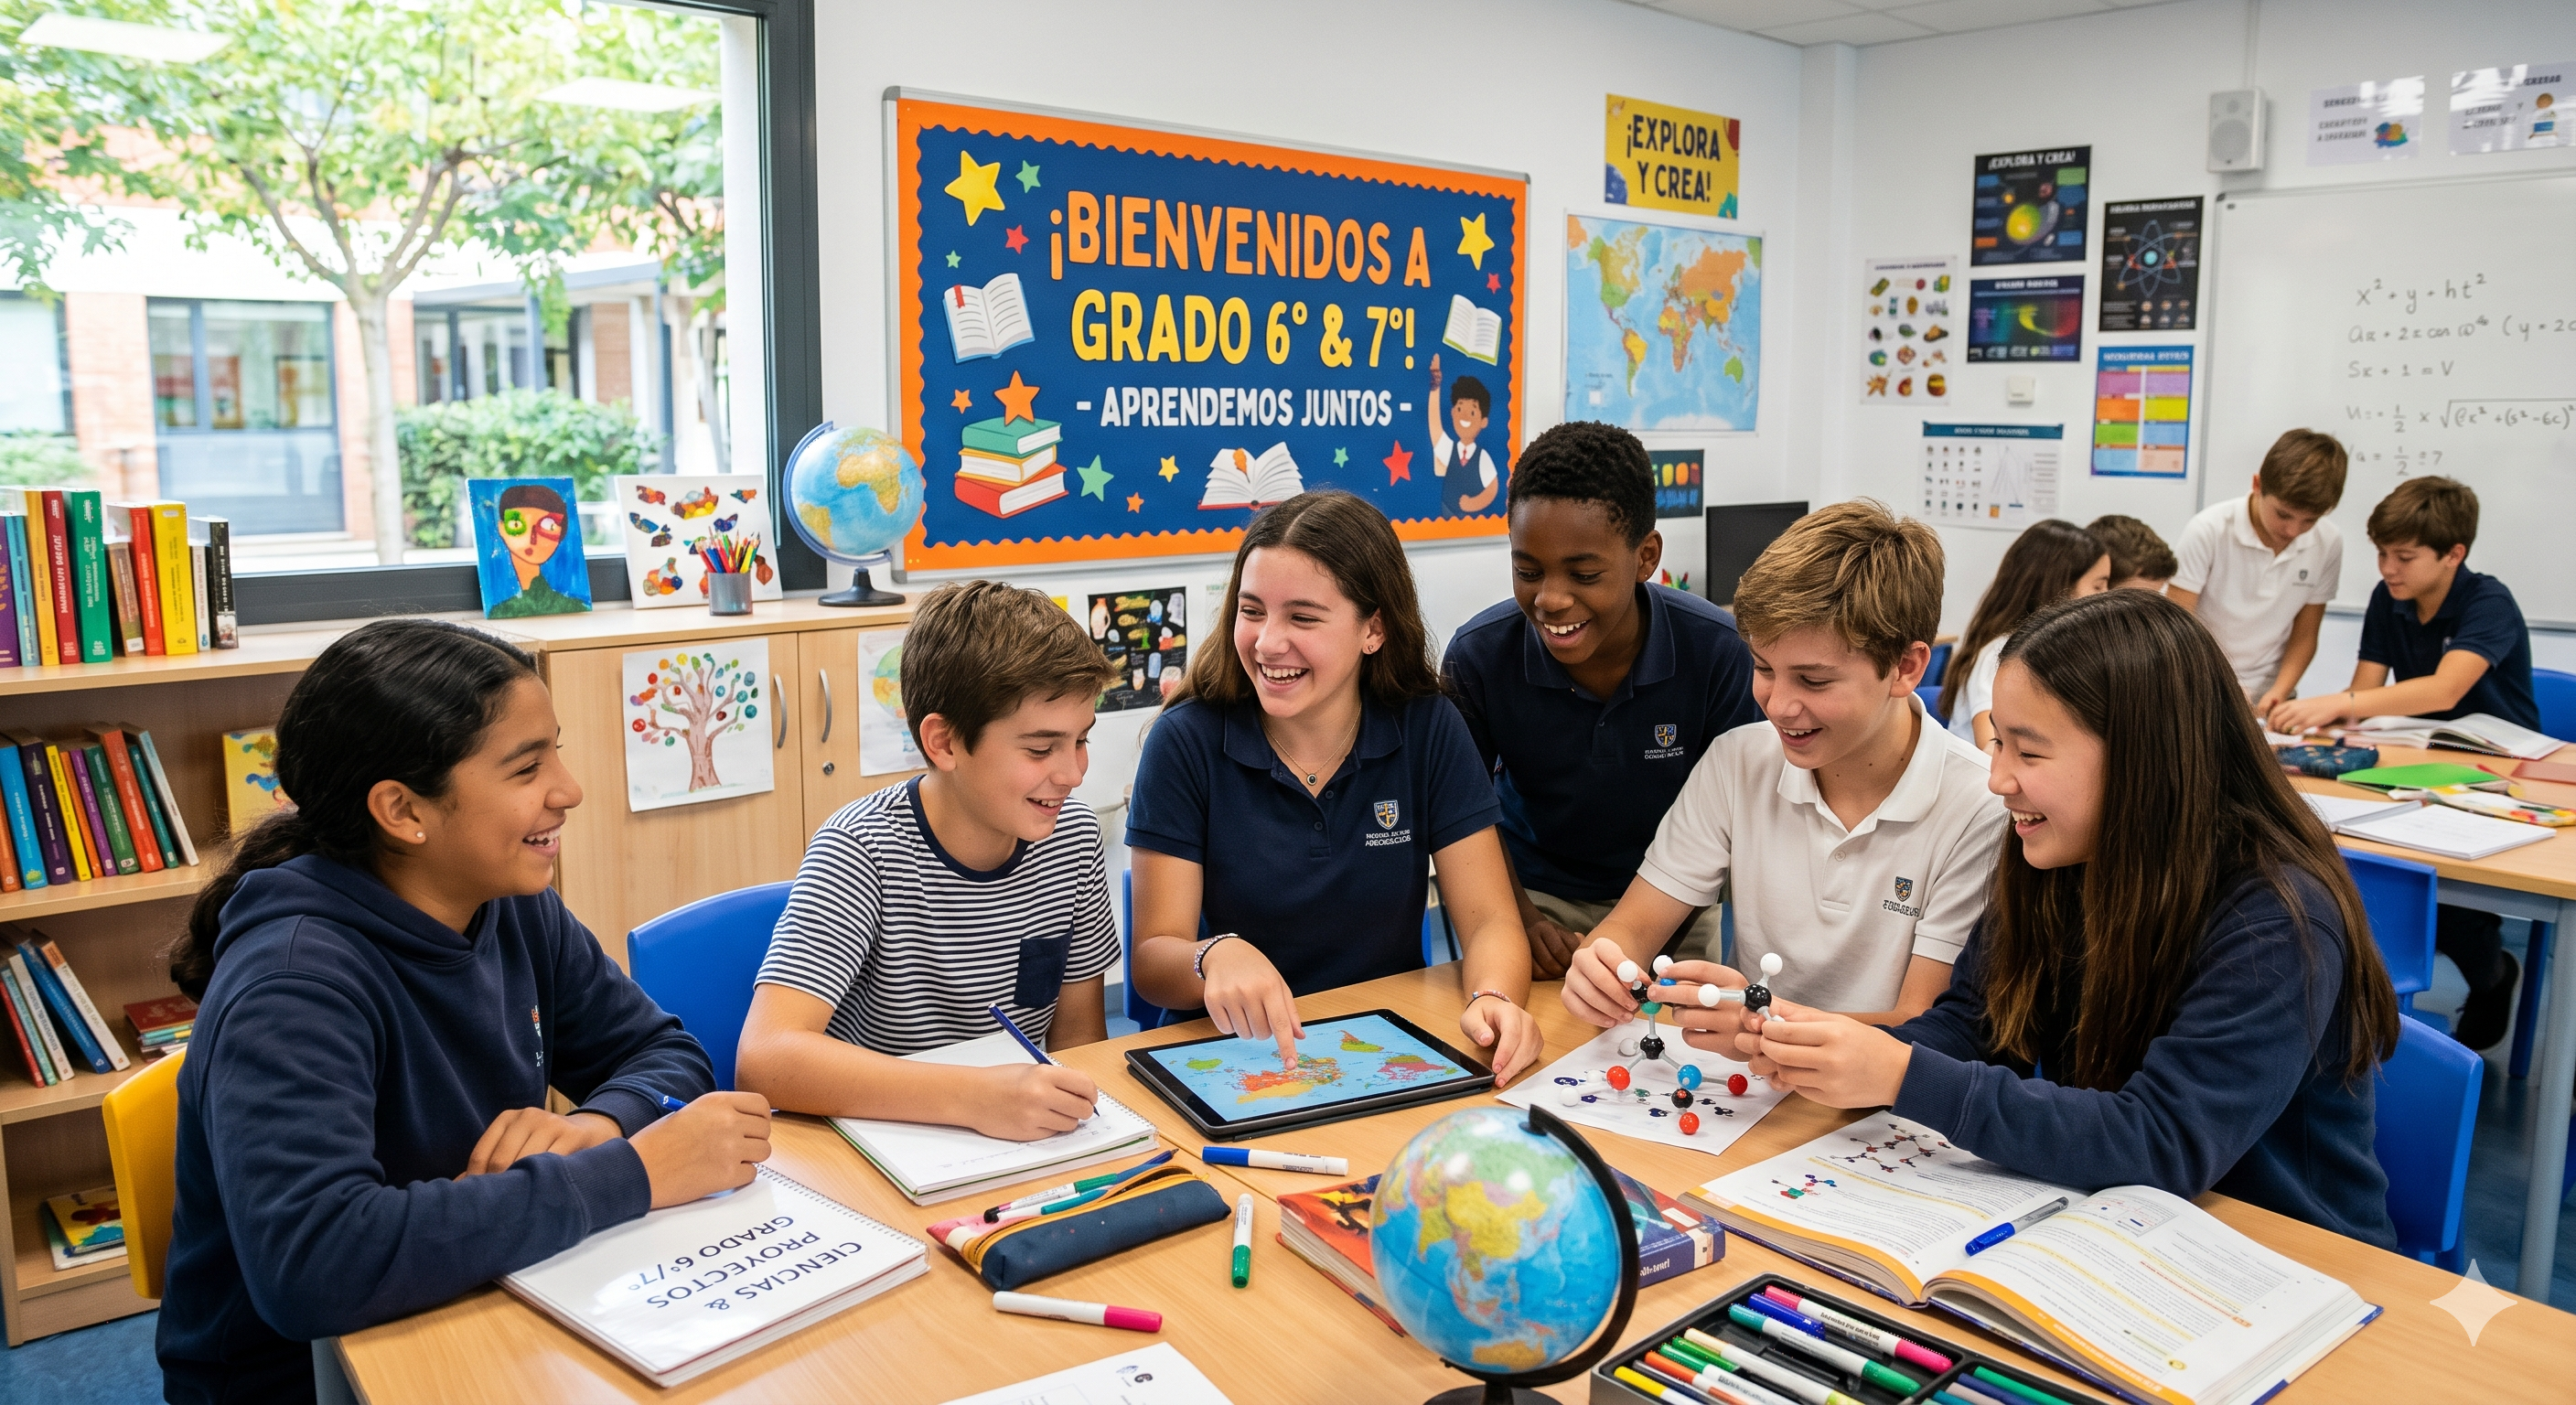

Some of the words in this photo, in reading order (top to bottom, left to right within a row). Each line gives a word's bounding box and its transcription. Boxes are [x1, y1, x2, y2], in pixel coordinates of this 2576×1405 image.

[1626, 113, 1721, 162] ¡EXPLORA
[1637, 160, 1649, 194] Y
[1655, 164, 1712, 203] CREA!
[1050, 190, 1391, 285] ¡BIENVENIDOS
[1404, 226, 1431, 288] A
[1071, 289, 1250, 364] GRADO
[1320, 304, 1352, 369] &
[1100, 387, 1293, 427] APRENDEMOS
[1301, 388, 1392, 428] JUNTOS
[699, 1216, 794, 1258] GRADO
[646, 1231, 821, 1309] PROYECTOS
[734, 1240, 863, 1300] CIENCIAS
[703, 1298, 731, 1312] &
